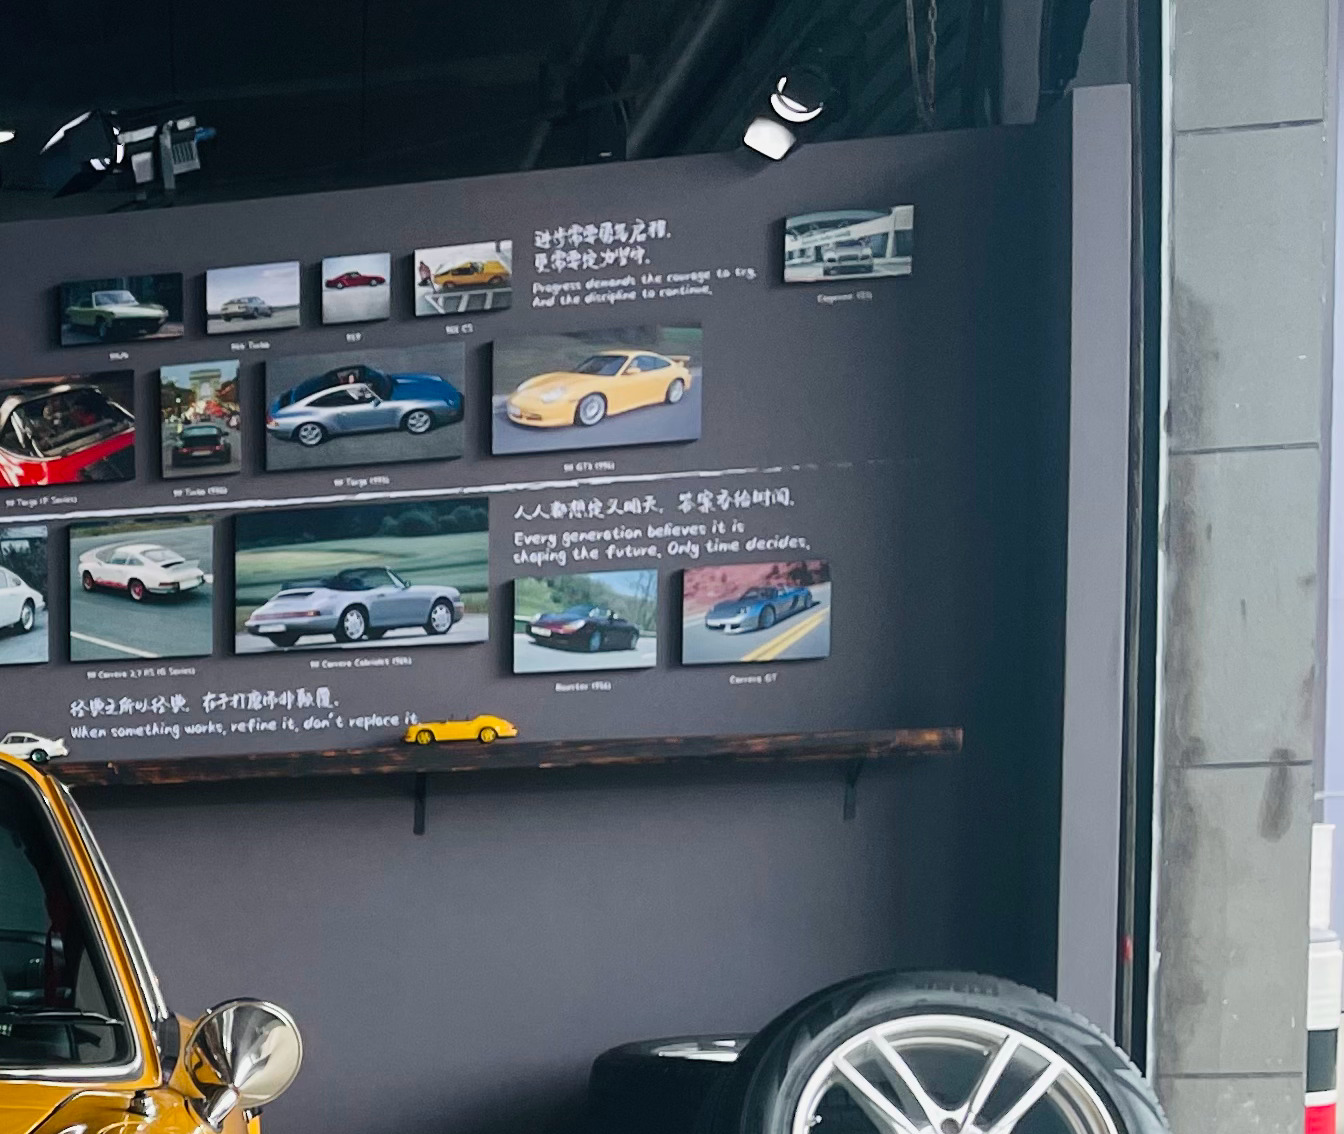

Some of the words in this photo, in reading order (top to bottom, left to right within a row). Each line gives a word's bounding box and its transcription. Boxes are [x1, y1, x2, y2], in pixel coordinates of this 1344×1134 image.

[641, 272, 662, 284] the
[666, 270, 710, 284] courage
[716, 268, 730, 278] to
[532, 296, 555, 307] And
[560, 294, 580, 305] the
[641, 288, 655, 298] to
[514, 530, 557, 548] Every
[562, 525, 643, 546] generation
[647, 522, 706, 538] believes
[712, 520, 727, 535] it
[731, 519, 744, 534] is
[513, 549, 567, 566] shaping
[572, 546, 599, 562] the
[667, 541, 700, 559] Only
[705, 538, 739, 553] time
[70, 723, 106, 740] When
[111, 720, 181, 741] something
[184, 719, 226, 737] works,
[231, 716, 276, 734] refine
[281, 715, 299, 732] it,
[302, 712, 344, 731] don't
[348, 712, 401, 731] replace
